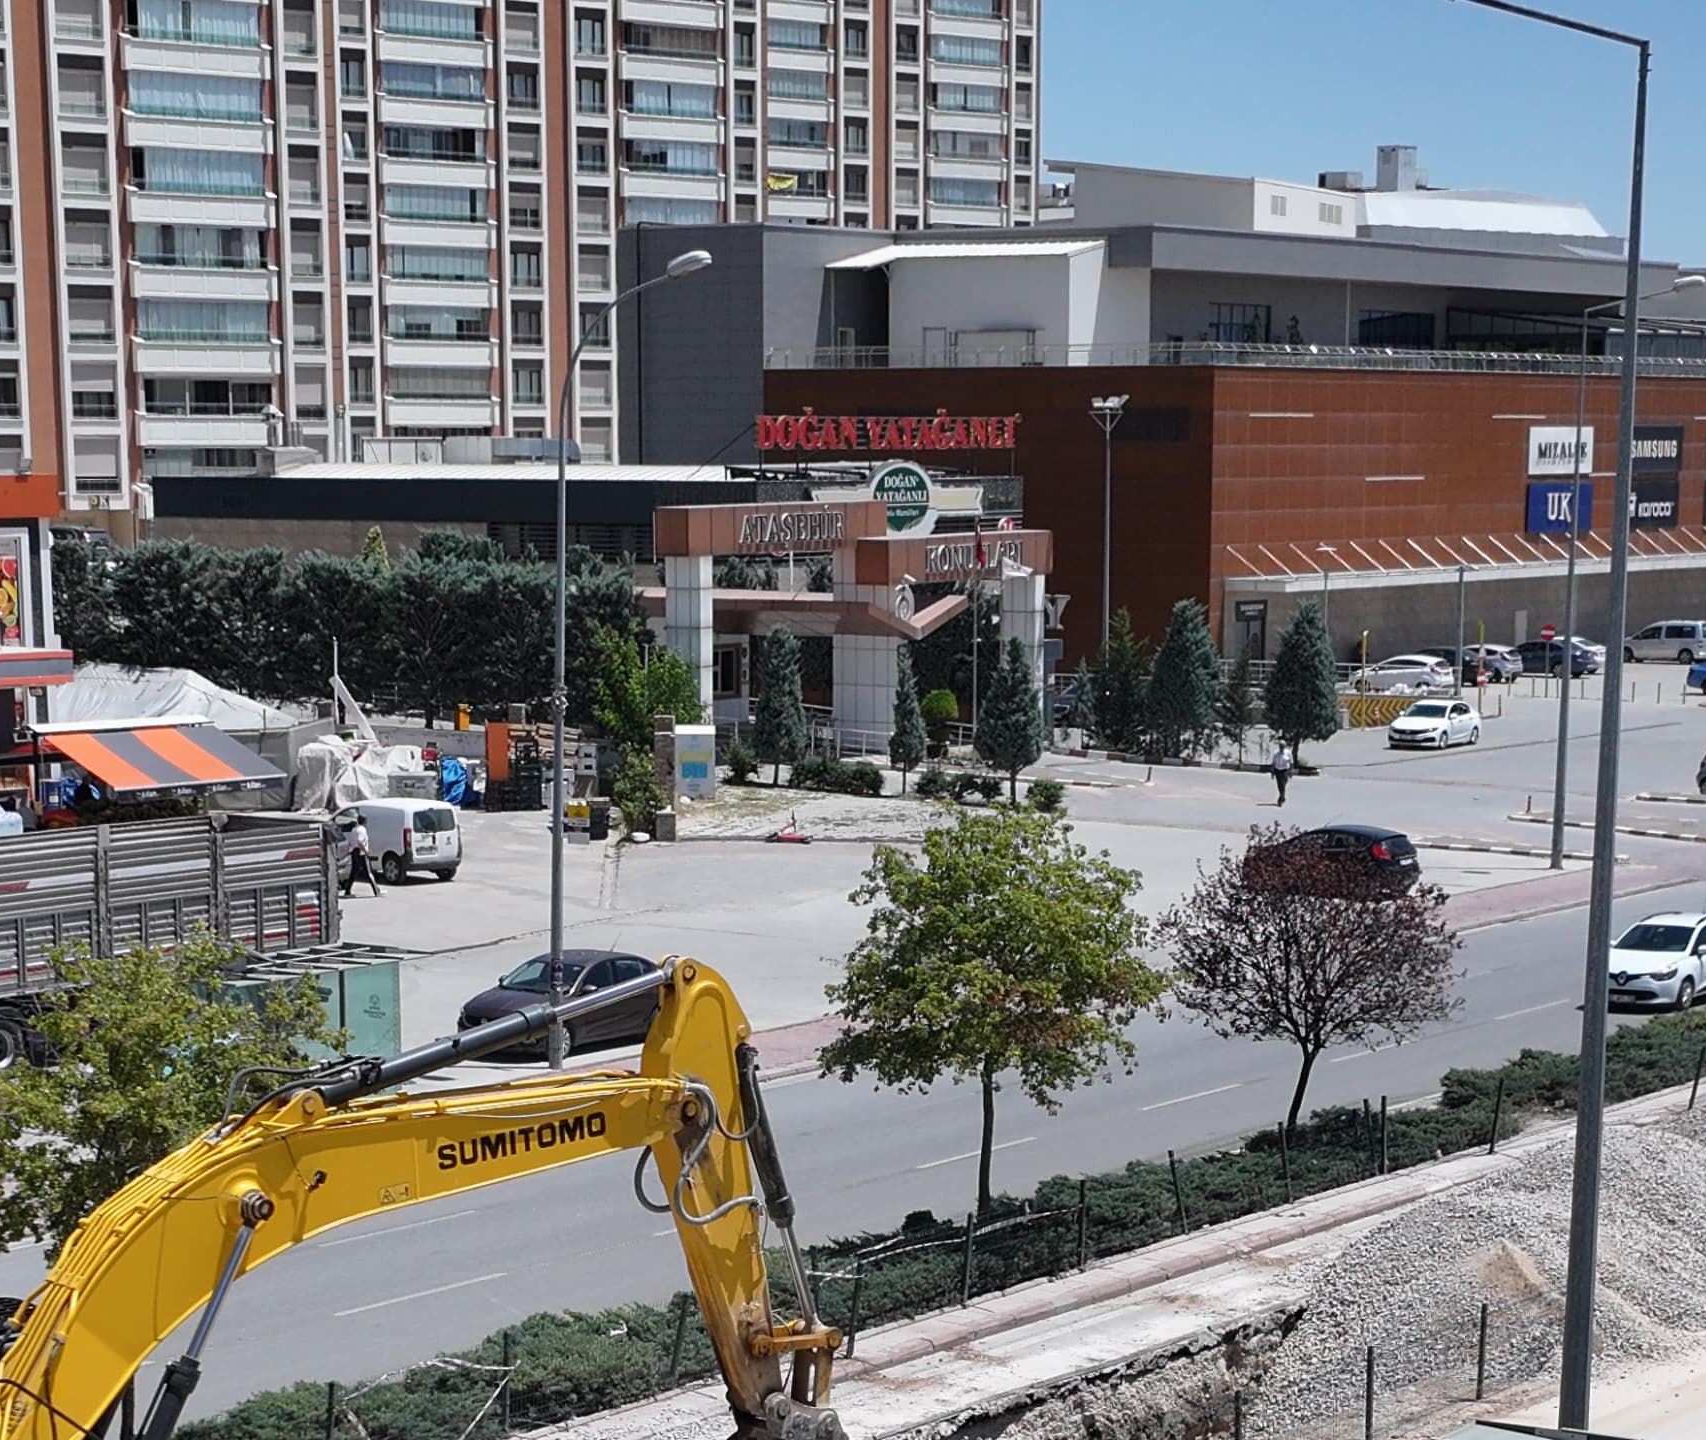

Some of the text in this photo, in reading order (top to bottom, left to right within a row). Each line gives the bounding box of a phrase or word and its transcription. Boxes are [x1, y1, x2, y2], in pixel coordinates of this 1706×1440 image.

[756, 406, 1017, 449] DOĞAN YATAĞANLI
[1538, 441, 1588, 459] MIZALE
[1631, 440, 1678, 458] SAMSUNG
[884, 473, 917, 488] DOĞAN
[739, 504, 844, 547] ATAŞEHİR
[925, 540, 1023, 573] KONULARI
[438, 1111, 607, 1171] SUMITOMO
